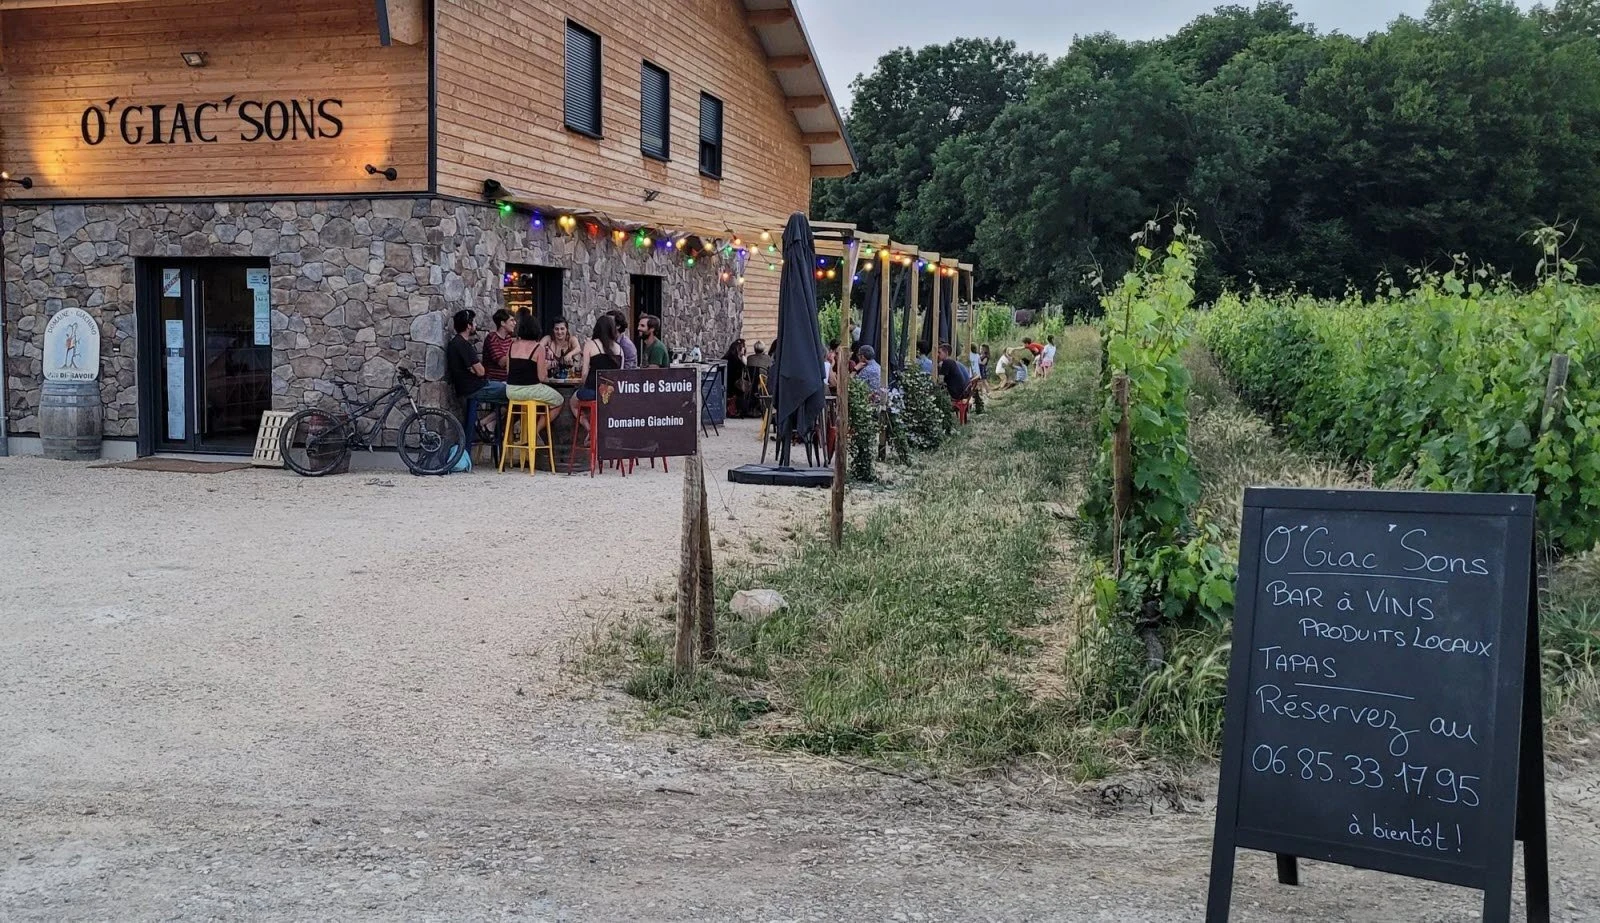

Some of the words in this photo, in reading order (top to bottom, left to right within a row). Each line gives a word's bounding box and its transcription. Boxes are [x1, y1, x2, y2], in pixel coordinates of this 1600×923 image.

[48, 311, 69, 333] DOMAINE
[617, 380, 640, 394] Vins
[643, 380, 655, 393] de
[658, 379, 692, 393] Savoie
[608, 417, 645, 428] Domaine
[647, 415, 684, 427] Giachino
[1266, 580, 1323, 607] BAR
[1337, 592, 1354, 611] à
[1366, 589, 1435, 620] VINS
[1299, 618, 1405, 647] PRODUITS
[1413, 627, 1492, 657] LOCAUX
[1259, 646, 1337, 678] TAPAS
[1256, 684, 1419, 756] Réservez
[1430, 716, 1478, 744] au
[1349, 814, 1363, 835] à
